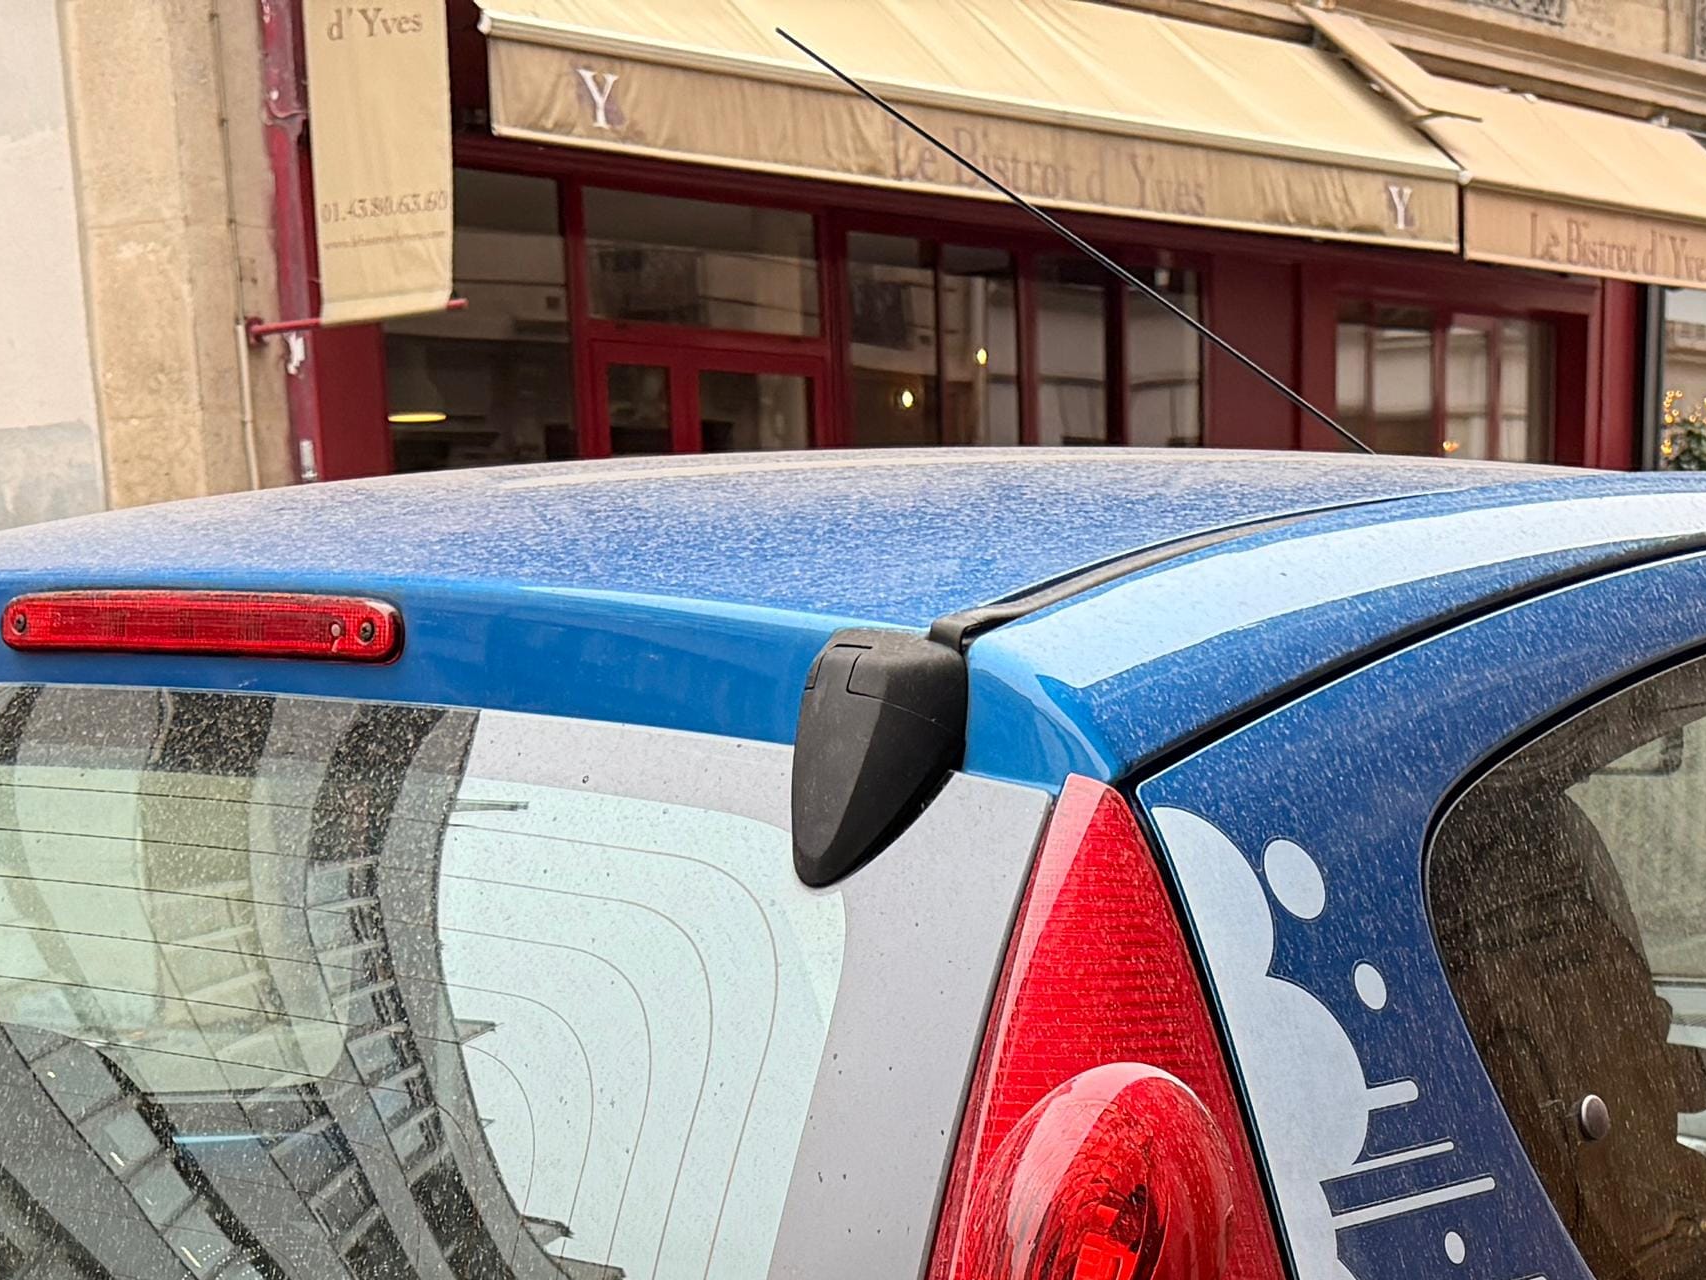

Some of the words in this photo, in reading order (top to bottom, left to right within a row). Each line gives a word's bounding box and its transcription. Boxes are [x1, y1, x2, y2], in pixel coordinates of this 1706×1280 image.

[326, 7, 424, 41] d'Yves
[577, 68, 619, 129] Y
[1388, 185, 1414, 230] Y
[1530, 212, 1560, 261] Le
[1566, 220, 1639, 275] Bistrot
